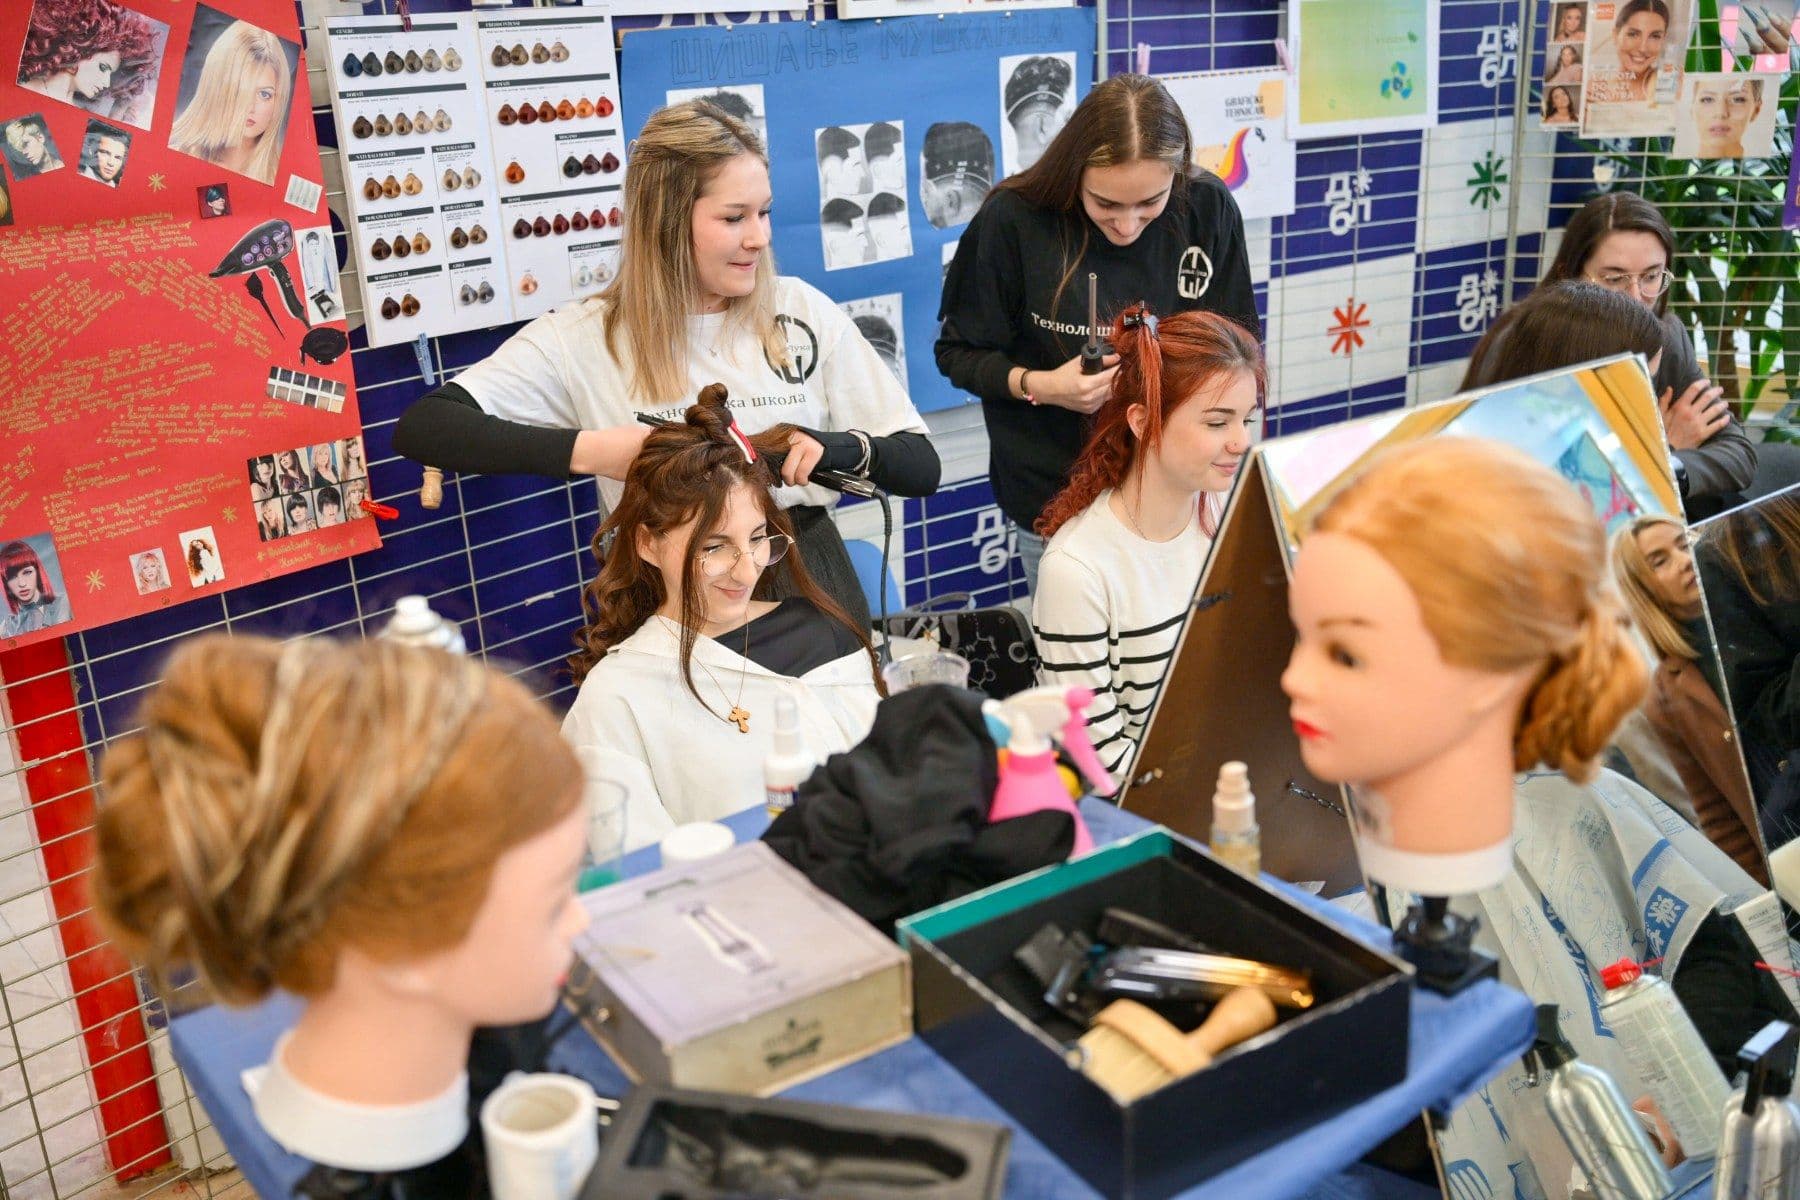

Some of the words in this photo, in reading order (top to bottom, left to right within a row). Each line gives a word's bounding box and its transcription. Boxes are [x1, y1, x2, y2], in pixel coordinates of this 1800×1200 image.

[671, 28, 859, 84] ШИШАЊЕ
[880, 14, 1065, 61] МУШКАРАЦА
[752, 392, 807, 407] школа
